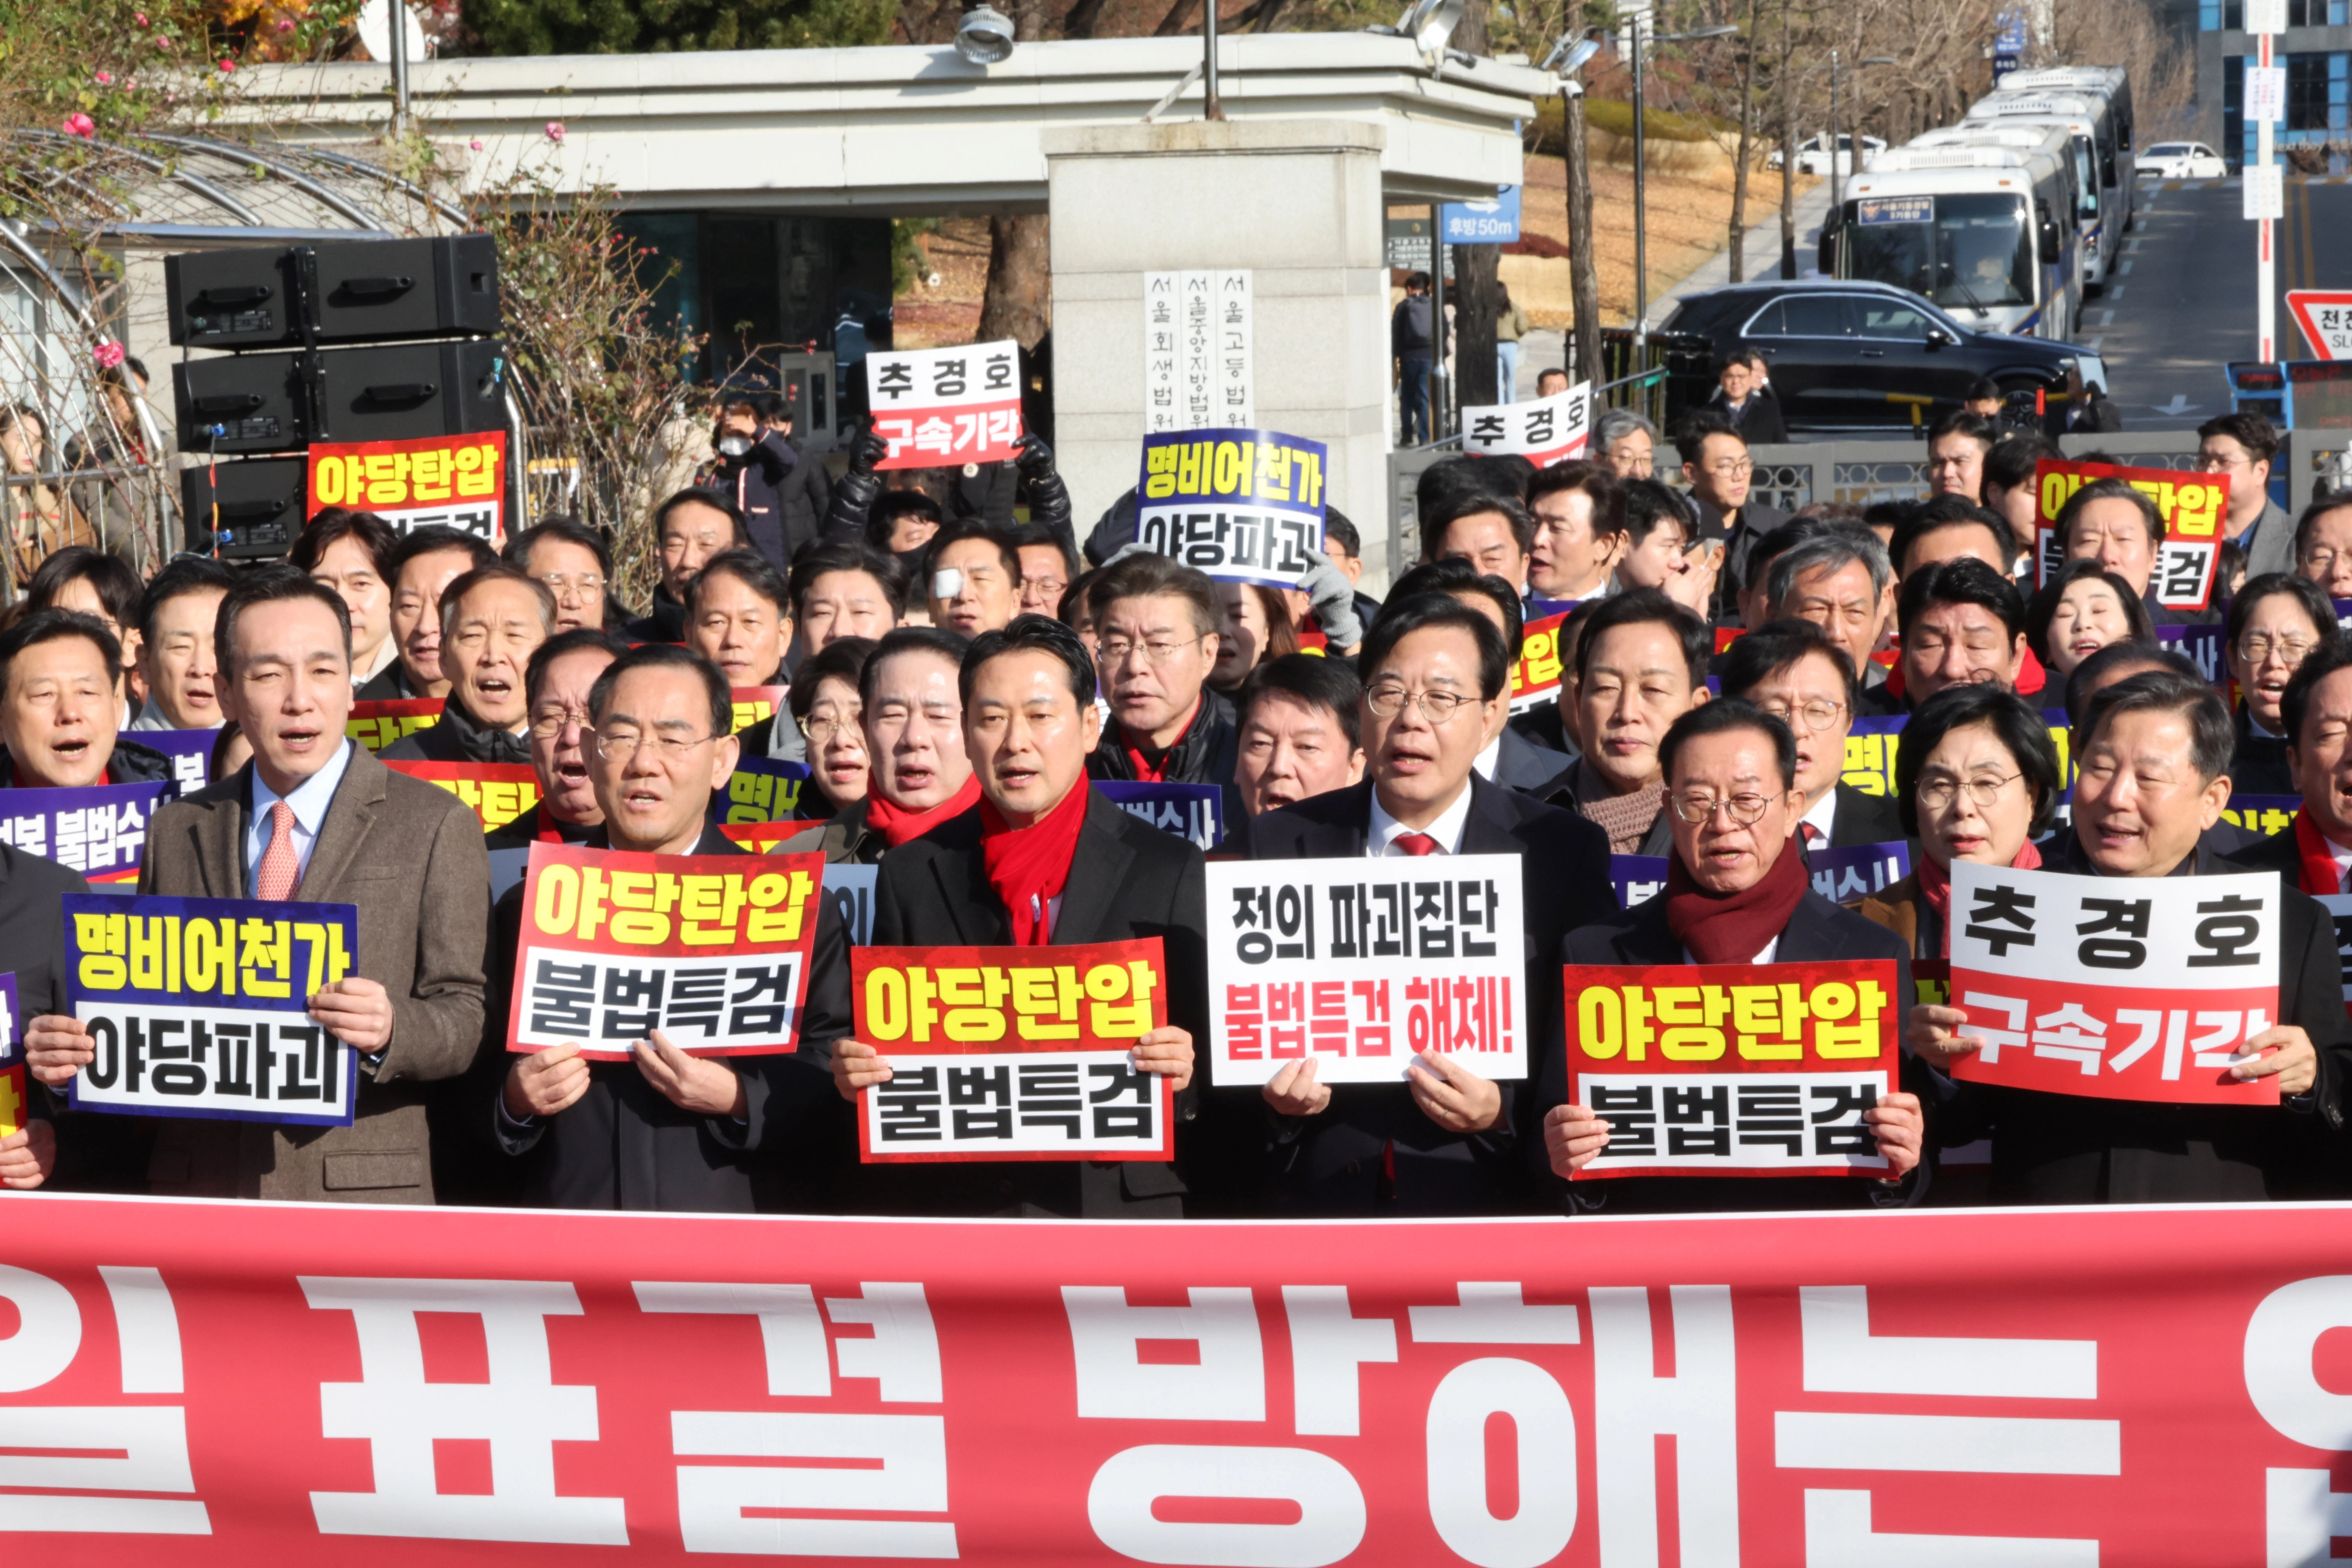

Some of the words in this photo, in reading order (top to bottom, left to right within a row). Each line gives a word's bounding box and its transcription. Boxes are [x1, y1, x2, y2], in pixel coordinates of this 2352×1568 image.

[1151, 277, 1174, 433] 서울회생법원
[1188, 277, 1210, 430] 서울중앙지방법원
[1224, 275, 1247, 429] 서울고등법원
[2332, 335, 2352, 349] SL
[878, 408, 1020, 458] 구속기각
[1145, 440, 1323, 508] 명비어천가
[315, 444, 500, 506] 야당탄압
[1144, 513, 1317, 574] 야당파괴
[56, 794, 172, 871] 불법수
[534, 863, 814, 945] 야당탄압
[1232, 884, 1315, 965] 정의
[1329, 879, 1499, 959] 파괴집단
[73, 913, 350, 998] 명비어천가
[530, 959, 793, 1041] 불법특검
[865, 959, 1158, 1042] 야당탄압
[1225, 978, 1392, 1061] 불법특검
[1405, 975, 1513, 1054] 해체!
[1578, 979, 1887, 1062] 야당탄압
[1957, 990, 2272, 1083] 구속기각
[85, 1015, 340, 1104] 야당파괴
[877, 1063, 1153, 1142] 불법특검
[1590, 1083, 1879, 1158] 불법특검
[295, 1276, 960, 1559] 표결
[1060, 1280, 2122, 1568] 방해는
